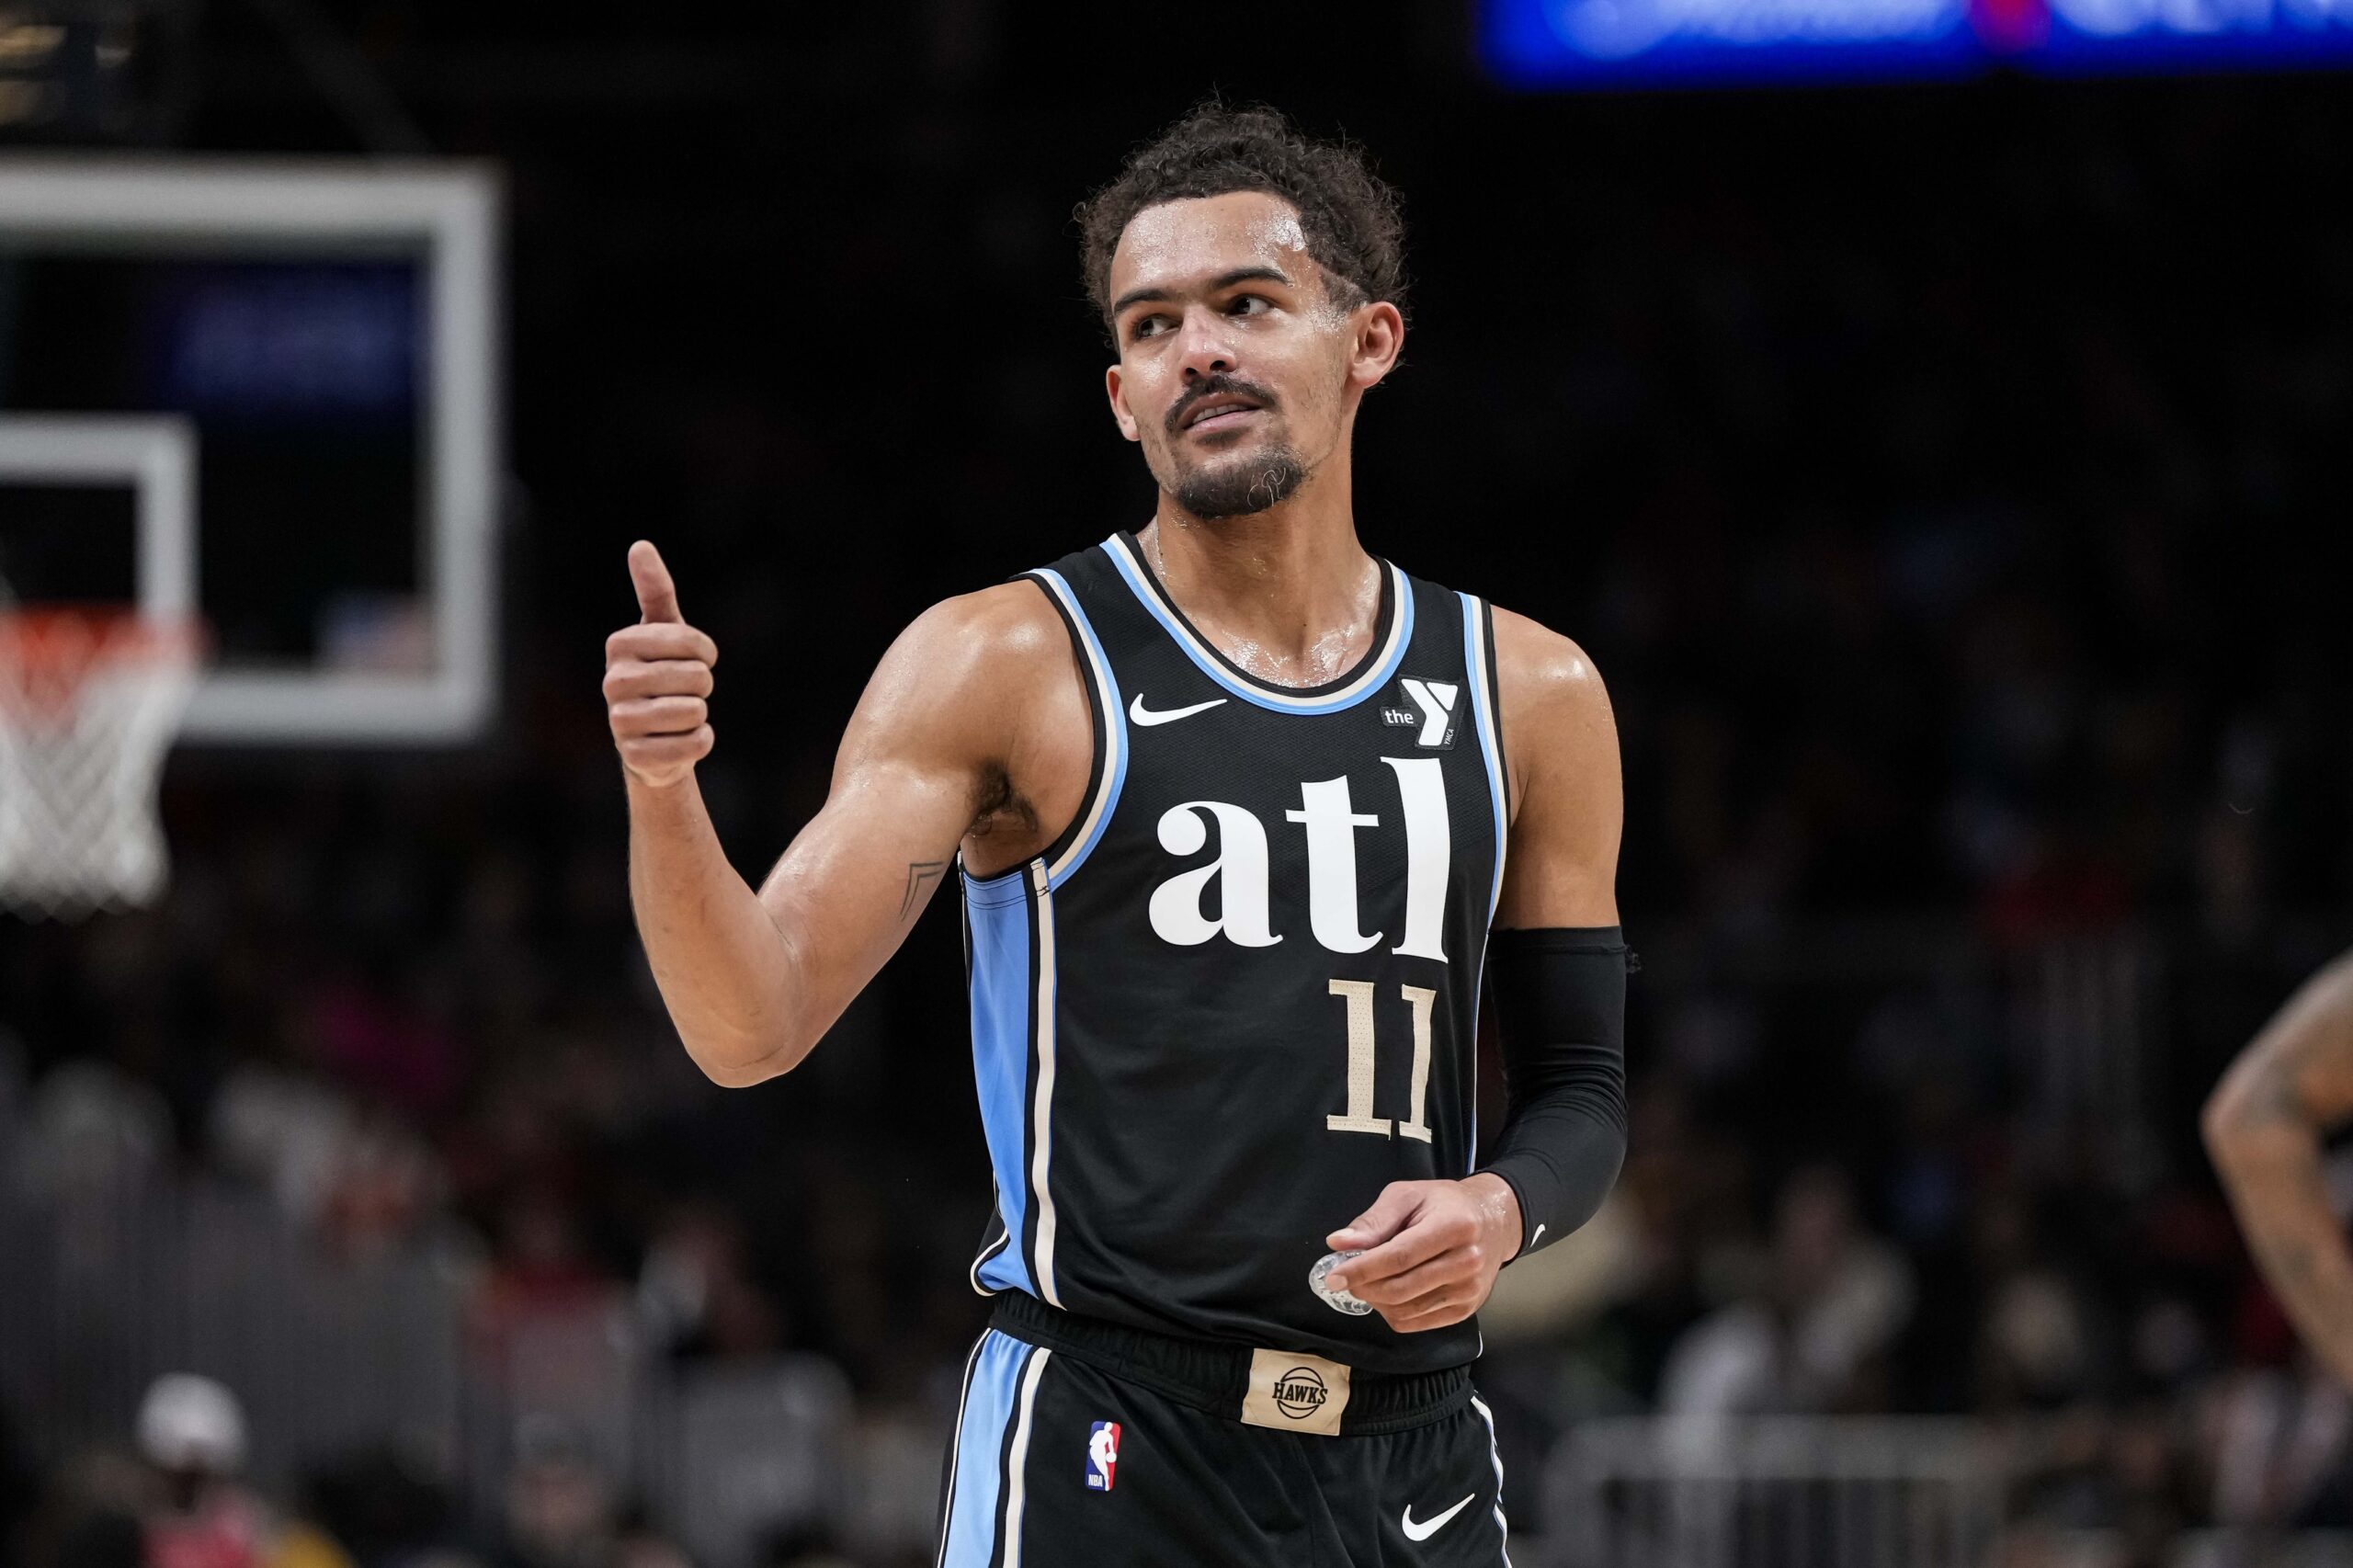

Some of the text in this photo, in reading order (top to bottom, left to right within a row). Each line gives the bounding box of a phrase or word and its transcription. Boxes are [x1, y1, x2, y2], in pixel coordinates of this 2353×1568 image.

[1385, 710, 1414, 724] the
[1444, 729, 1454, 745] YMCA
[1148, 756, 1450, 963] atl
[1326, 979, 1437, 1143] 11
[1272, 1381, 1328, 1404] HAWKS
[1087, 1473, 1103, 1487] NBA
